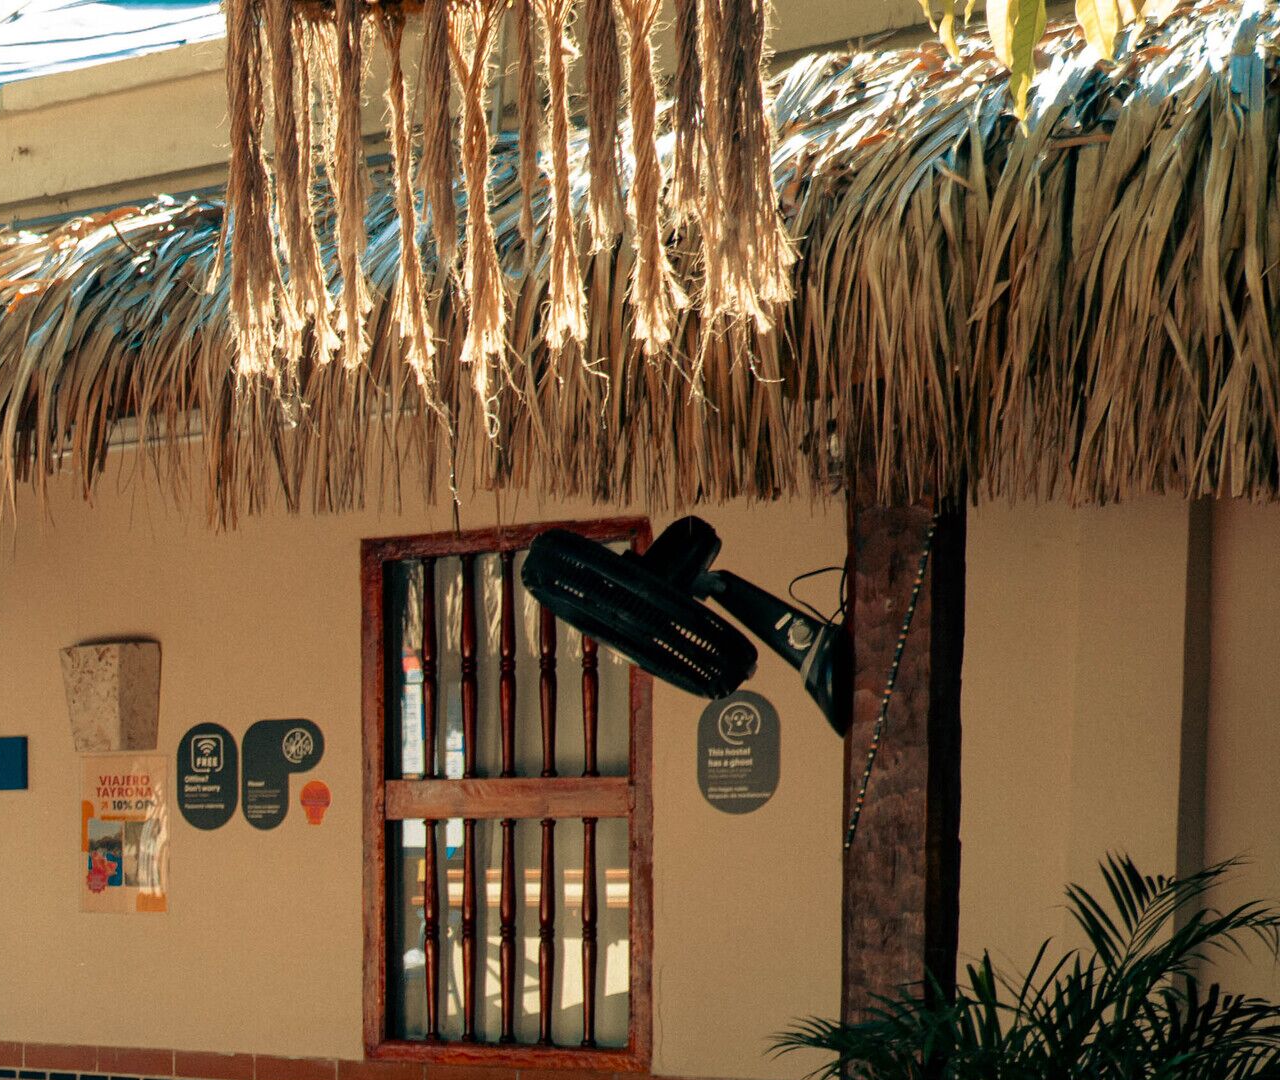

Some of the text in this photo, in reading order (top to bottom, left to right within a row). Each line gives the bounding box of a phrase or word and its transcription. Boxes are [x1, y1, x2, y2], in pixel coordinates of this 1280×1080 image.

[708, 748, 724, 757] This
[196, 756, 218, 768] FREE
[708, 758, 722, 768] has
[99, 774, 150, 786] VIAJERO
[96, 787, 153, 798] TAYRONA
[184, 785, 201, 793] Don't
[112, 800, 132, 811] 10%
